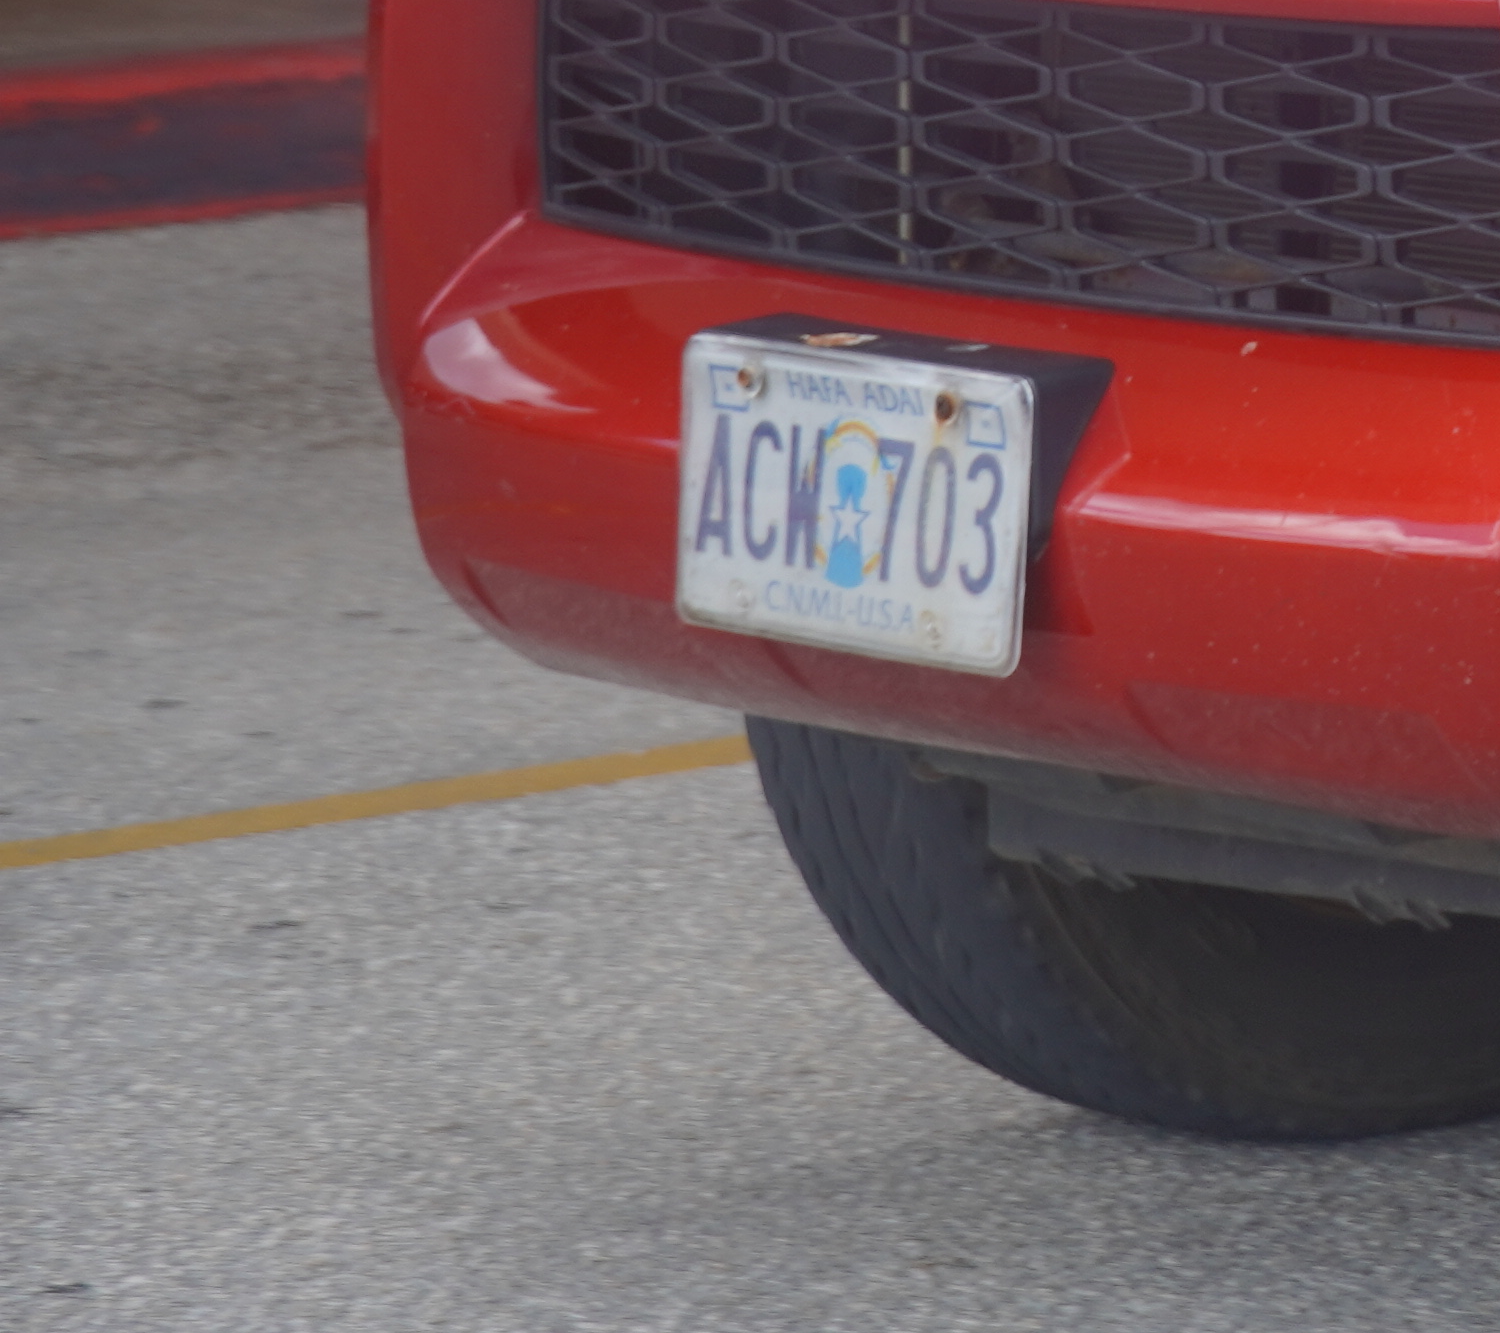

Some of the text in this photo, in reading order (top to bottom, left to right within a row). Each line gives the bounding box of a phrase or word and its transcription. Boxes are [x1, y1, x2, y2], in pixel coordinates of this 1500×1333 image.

[786, 371, 924, 416] HAFA ADAI
[695, 413, 1004, 595] ACW 703
